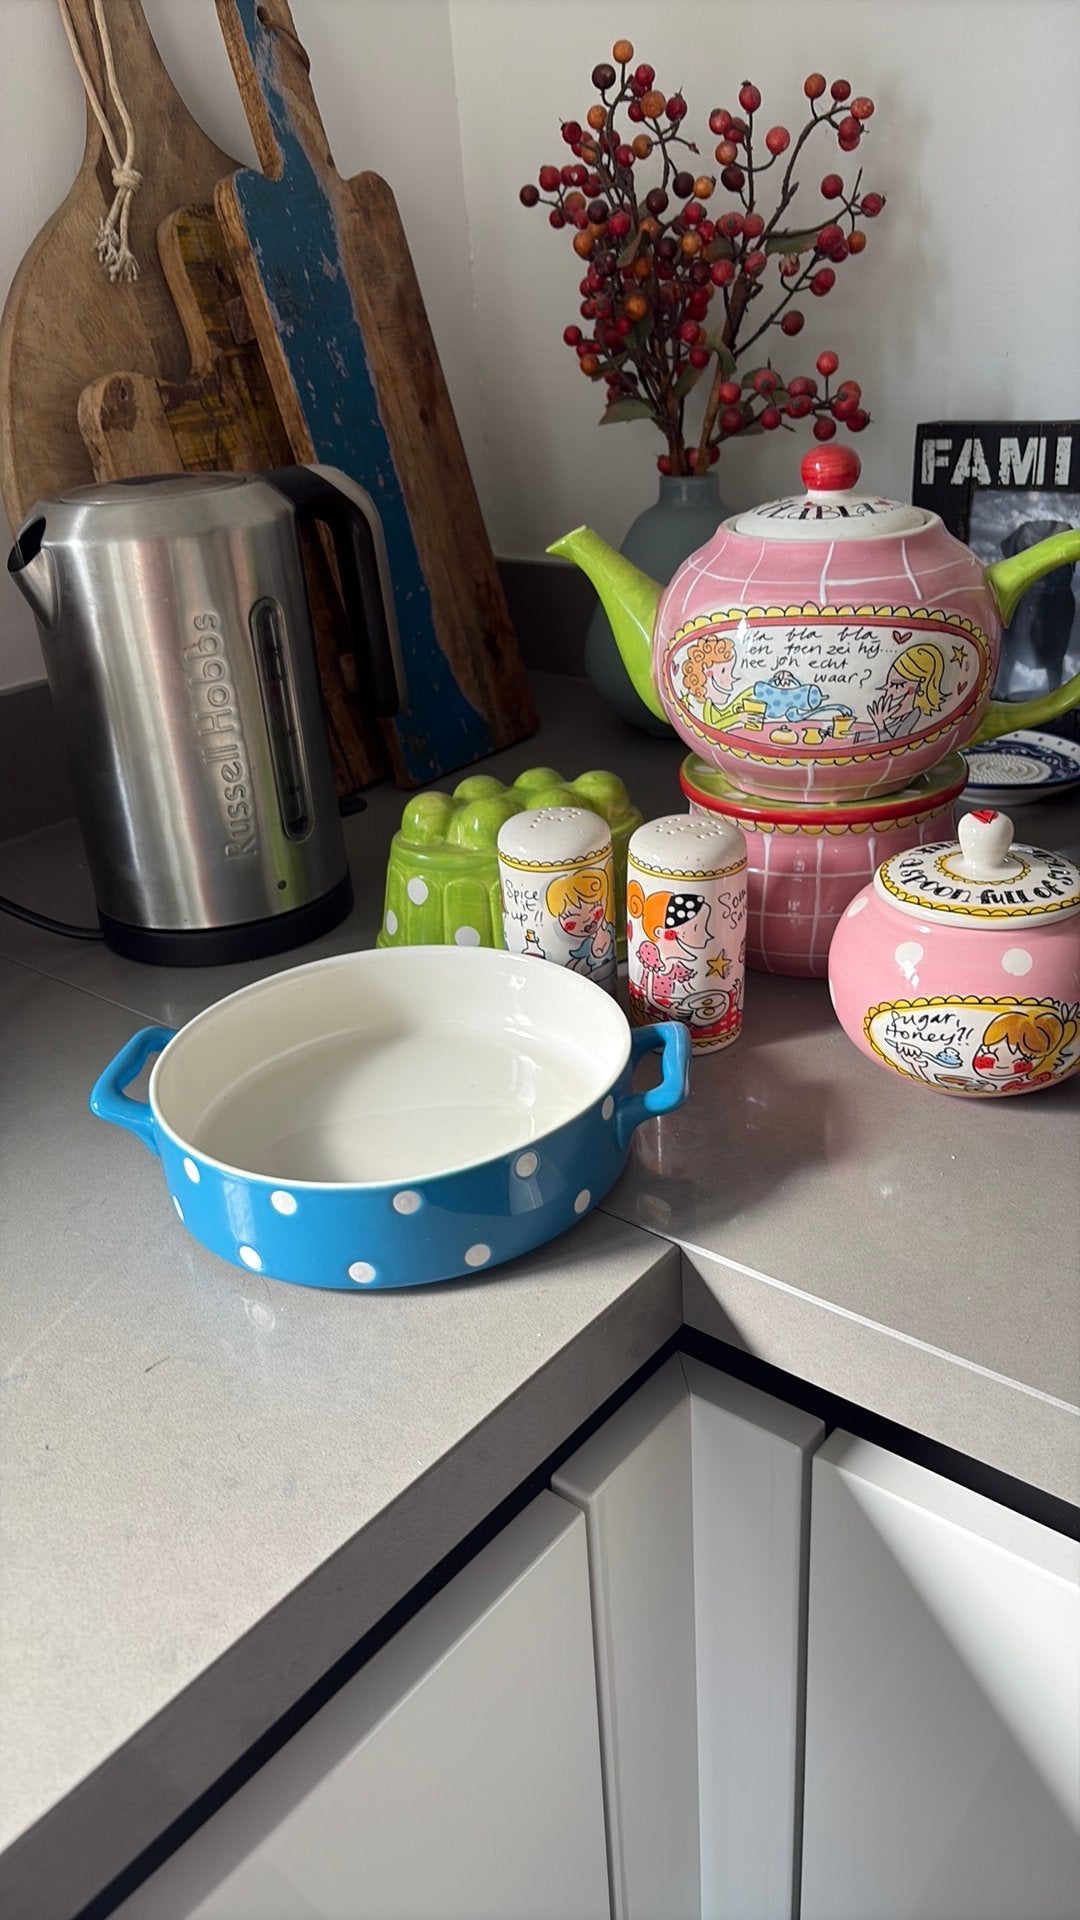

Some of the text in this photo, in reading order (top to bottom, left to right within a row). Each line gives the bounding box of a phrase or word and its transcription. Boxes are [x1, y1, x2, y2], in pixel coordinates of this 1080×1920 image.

[920, 436, 1073, 486] FAMI
[785, 627, 823, 642] bla
[837, 626, 879, 641] bla
[749, 644, 773, 655] en
[784, 643, 822, 656] toen
[827, 642, 851, 656] zei
[740, 658, 767, 669] nee
[808, 658, 849, 670] echt
[813, 668, 873, 689] waar?
[184, 611, 257, 860] Russell Hobbs
[504, 878, 539, 906] Spice
[900, 868, 971, 903] spoon
[977, 888, 1034, 906] full
[1033, 879, 1065, 899] of
[520, 900, 537, 912] it
[890, 1009, 961, 1031] Sugar,
